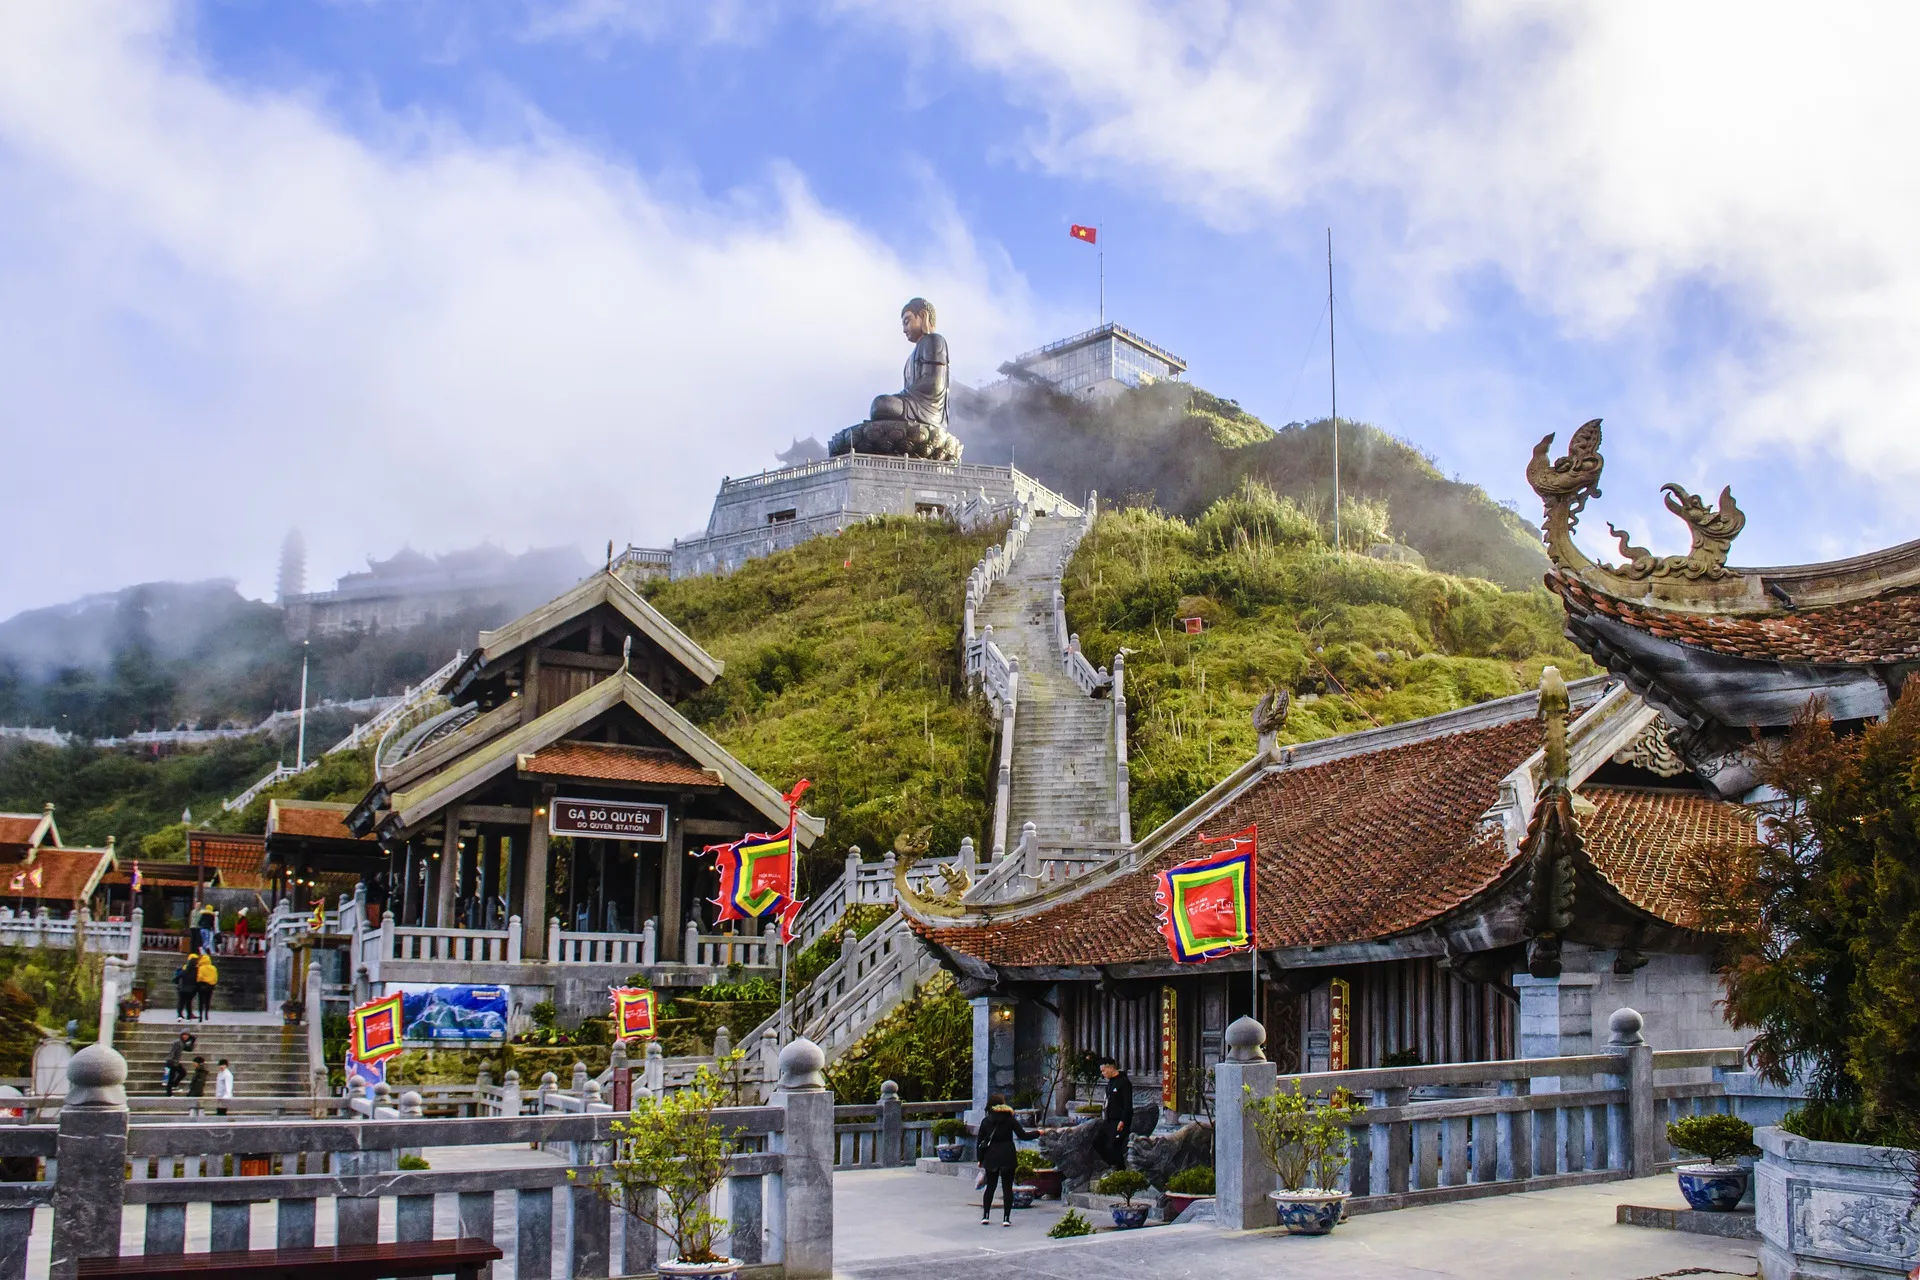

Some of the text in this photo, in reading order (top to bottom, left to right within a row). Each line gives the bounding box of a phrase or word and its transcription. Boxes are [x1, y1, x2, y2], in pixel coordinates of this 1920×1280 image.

[568, 808, 586, 820] GA
[589, 822, 613, 830] QUYEN
[615, 824, 644, 832] STATION
